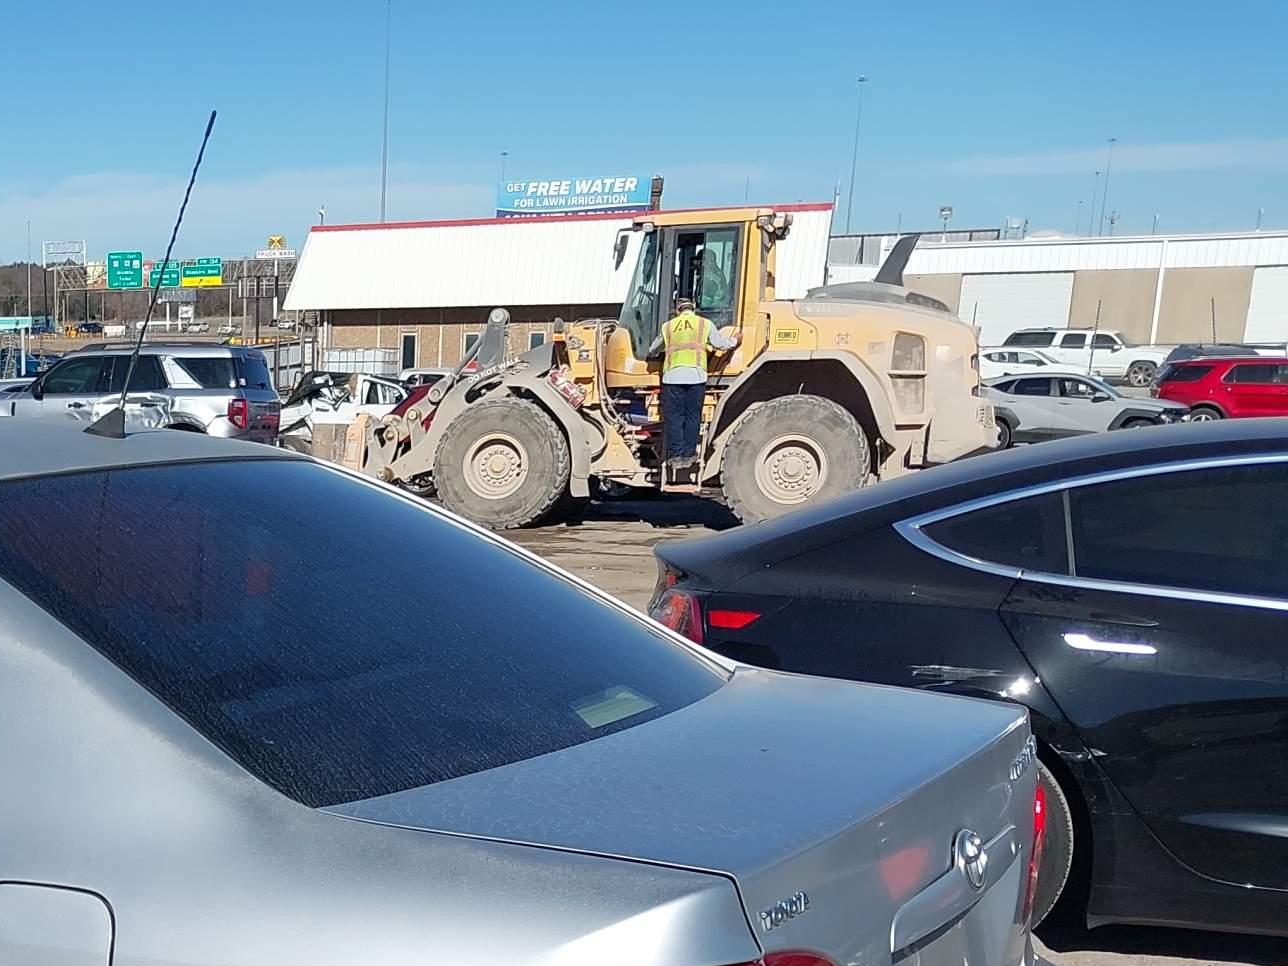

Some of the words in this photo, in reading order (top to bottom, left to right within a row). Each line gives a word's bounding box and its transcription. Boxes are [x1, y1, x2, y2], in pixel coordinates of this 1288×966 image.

[507, 183, 526, 193] GET
[526, 180, 572, 197] FREE
[575, 177, 638, 196] WATER
[514, 199, 534, 208] FOR
[536, 197, 566, 207] LAWN
[567, 194, 628, 206] IRRIGATION
[467, 374, 480, 383] DO
[480, 364, 497, 379] NOT
[498, 356, 520, 370] WALK
